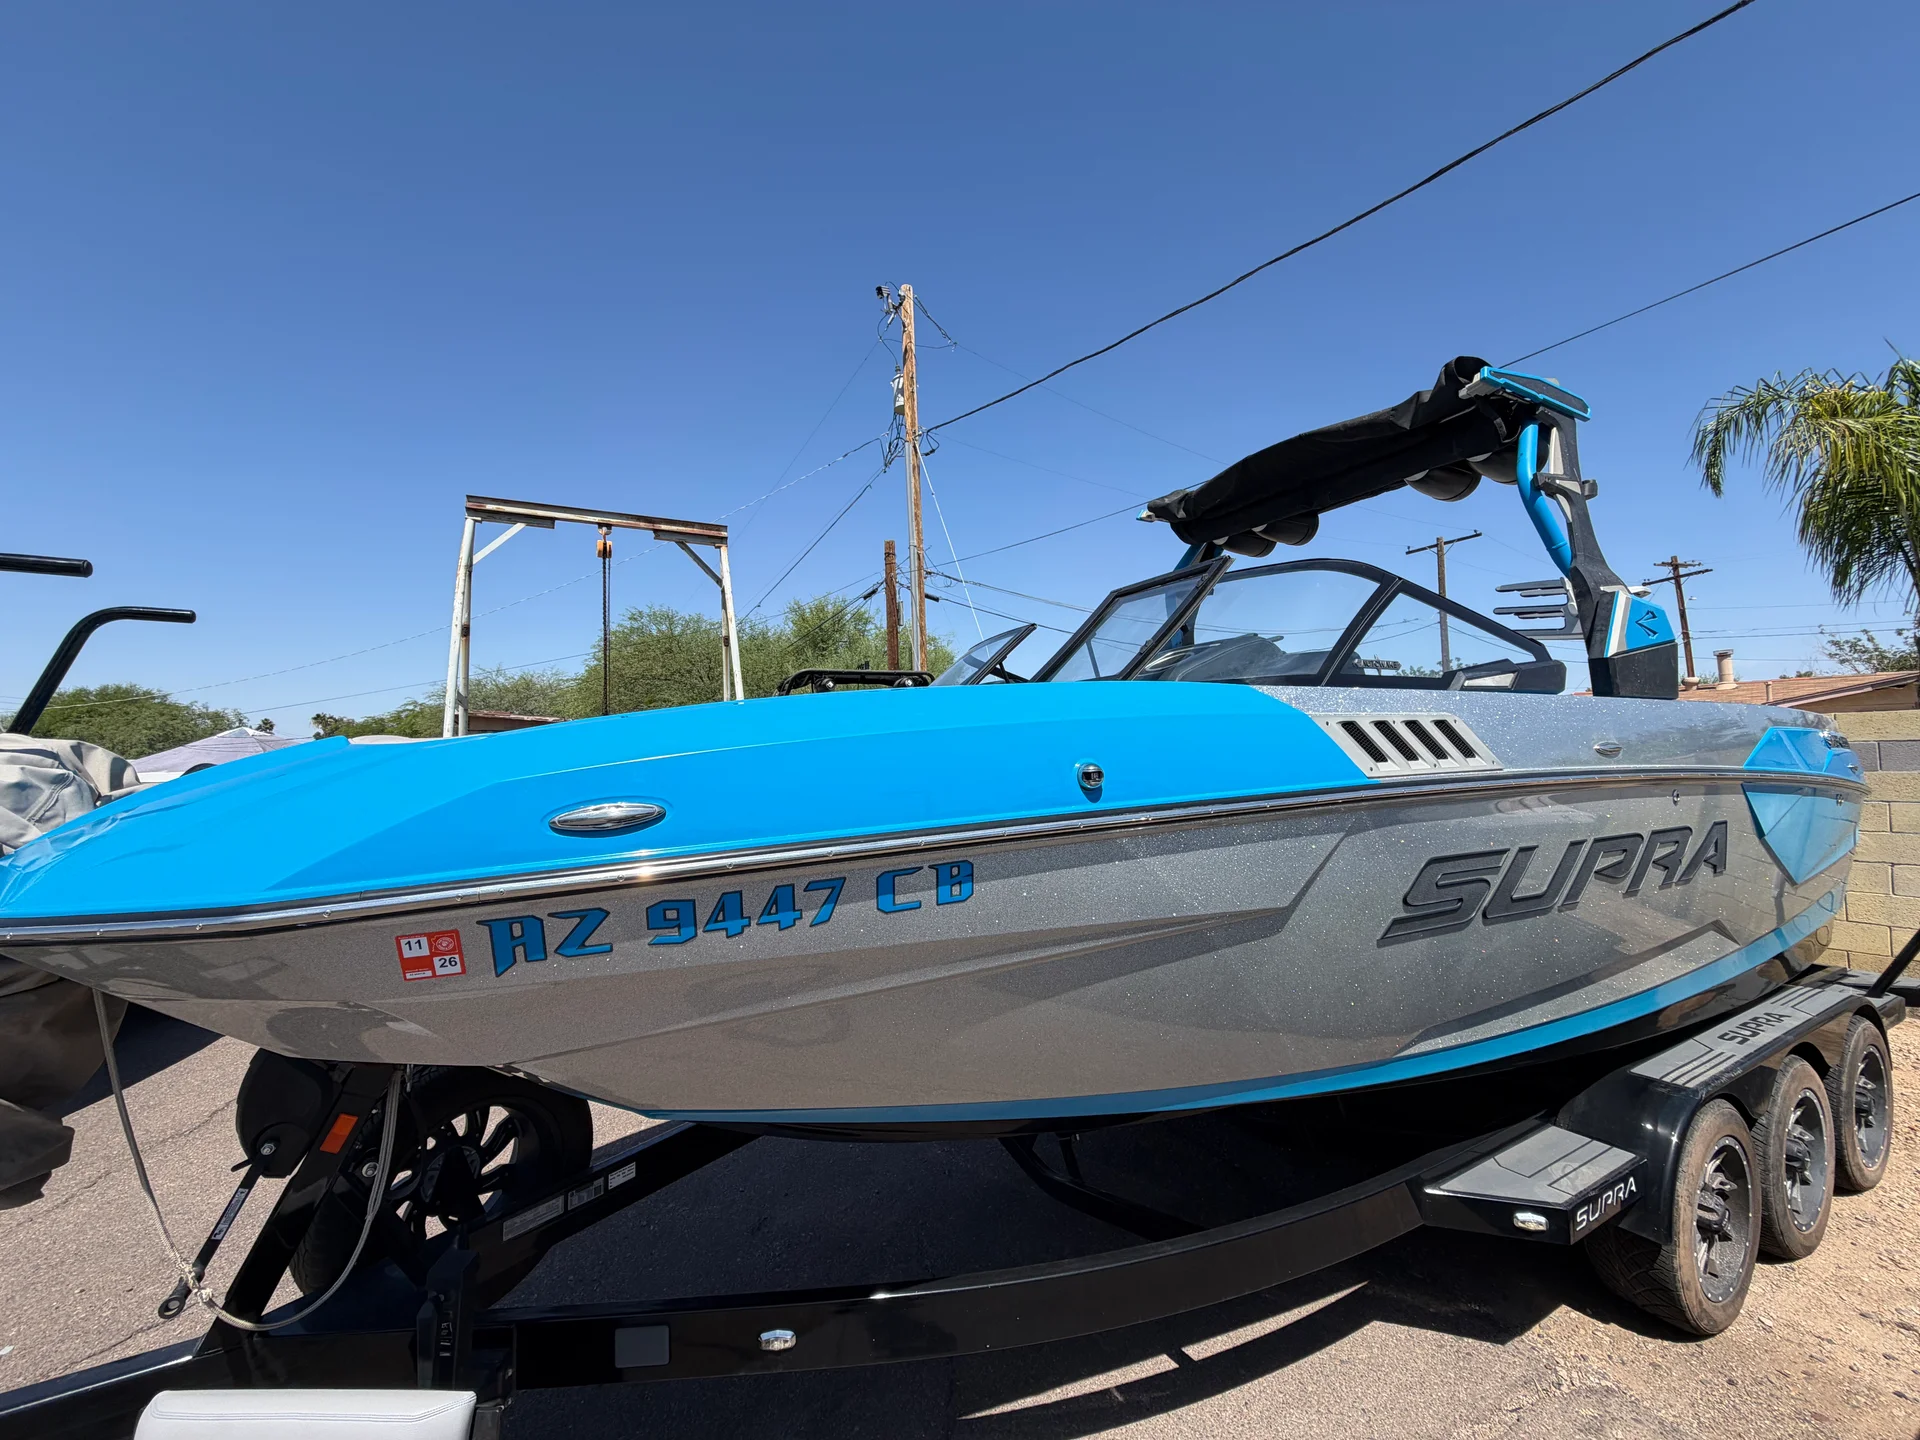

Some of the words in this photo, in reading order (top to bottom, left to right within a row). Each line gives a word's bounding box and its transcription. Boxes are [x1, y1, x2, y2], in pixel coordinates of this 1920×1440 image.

[1377, 820, 1728, 946] SUPRA
[476, 908, 614, 977] AZ
[646, 877, 847, 946] 9447
[877, 859, 974, 914] CB
[404, 939, 423, 951] 11
[438, 956, 458, 968] 26
[1718, 1011, 1792, 1046] SUPRA
[1575, 1176, 1638, 1232] SUPRA
